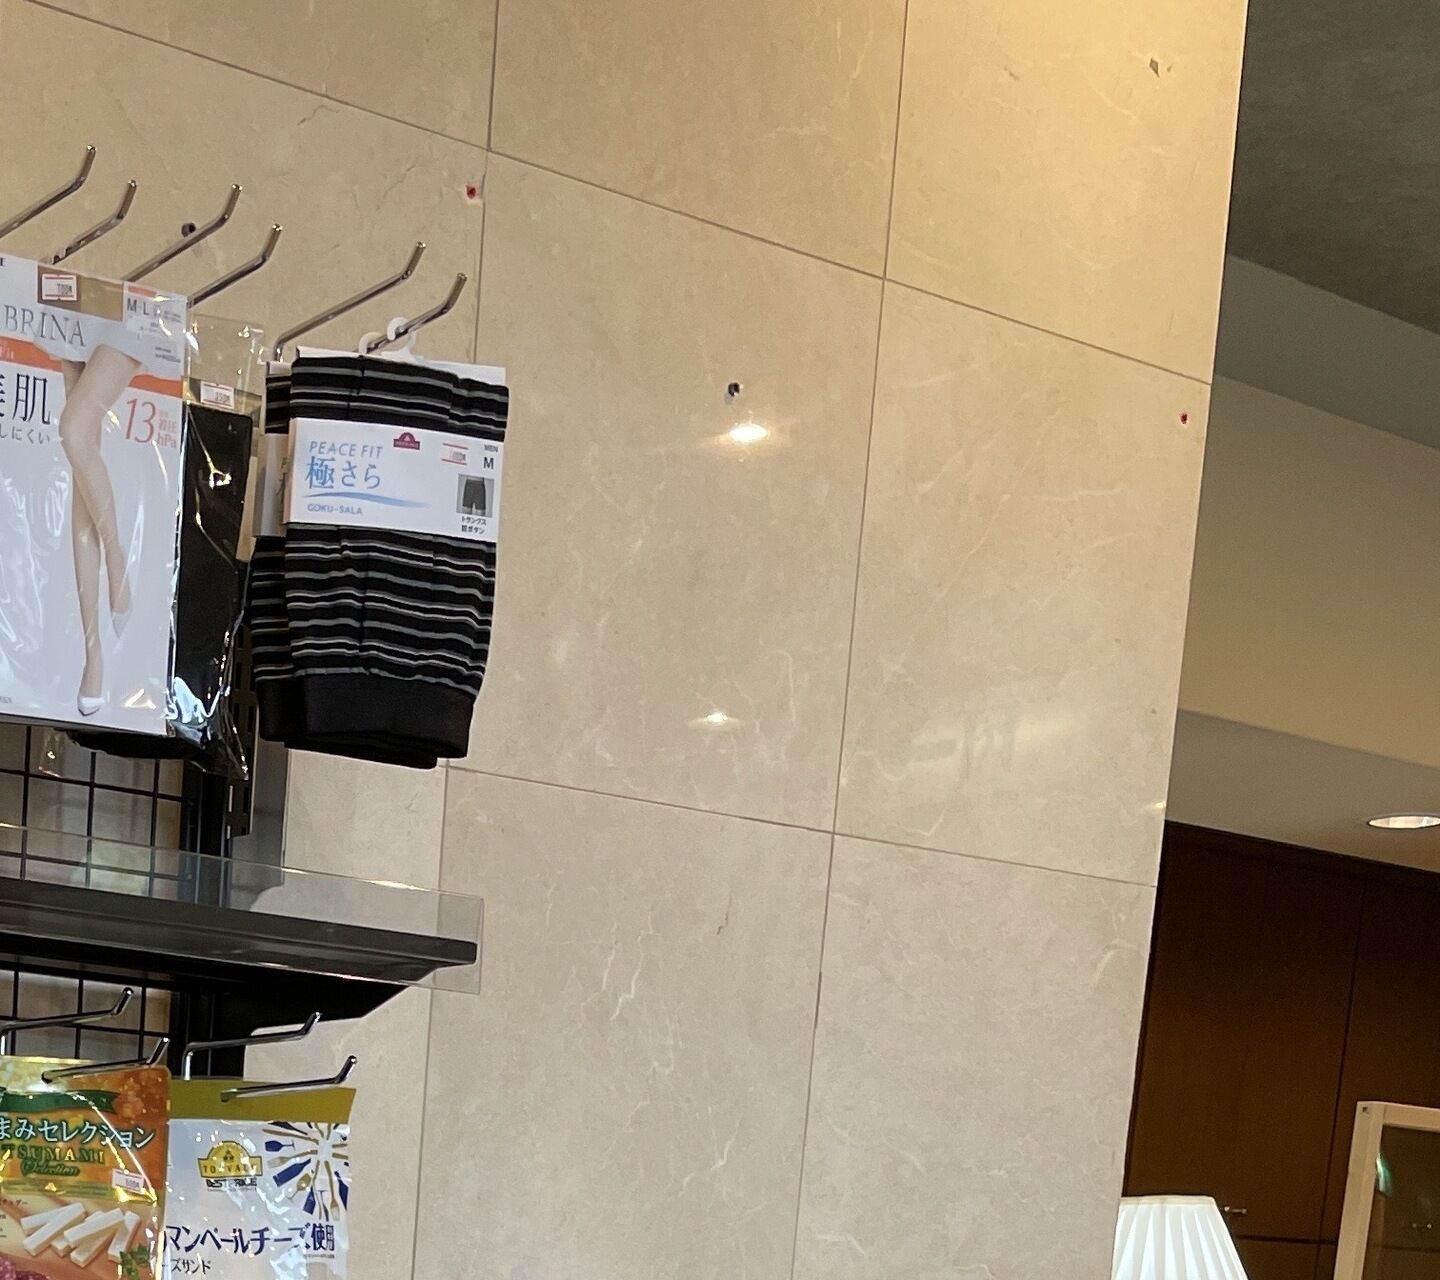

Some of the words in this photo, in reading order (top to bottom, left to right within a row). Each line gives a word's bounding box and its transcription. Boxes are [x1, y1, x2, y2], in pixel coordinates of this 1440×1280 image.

[125, 397, 157, 445] 13
[310, 440, 357, 458] PEACE
[361, 445, 384, 460] FIT
[304, 455, 382, 490] 極さら
[482, 456, 495, 470] M
[306, 503, 364, 516] GOKU-SALA
